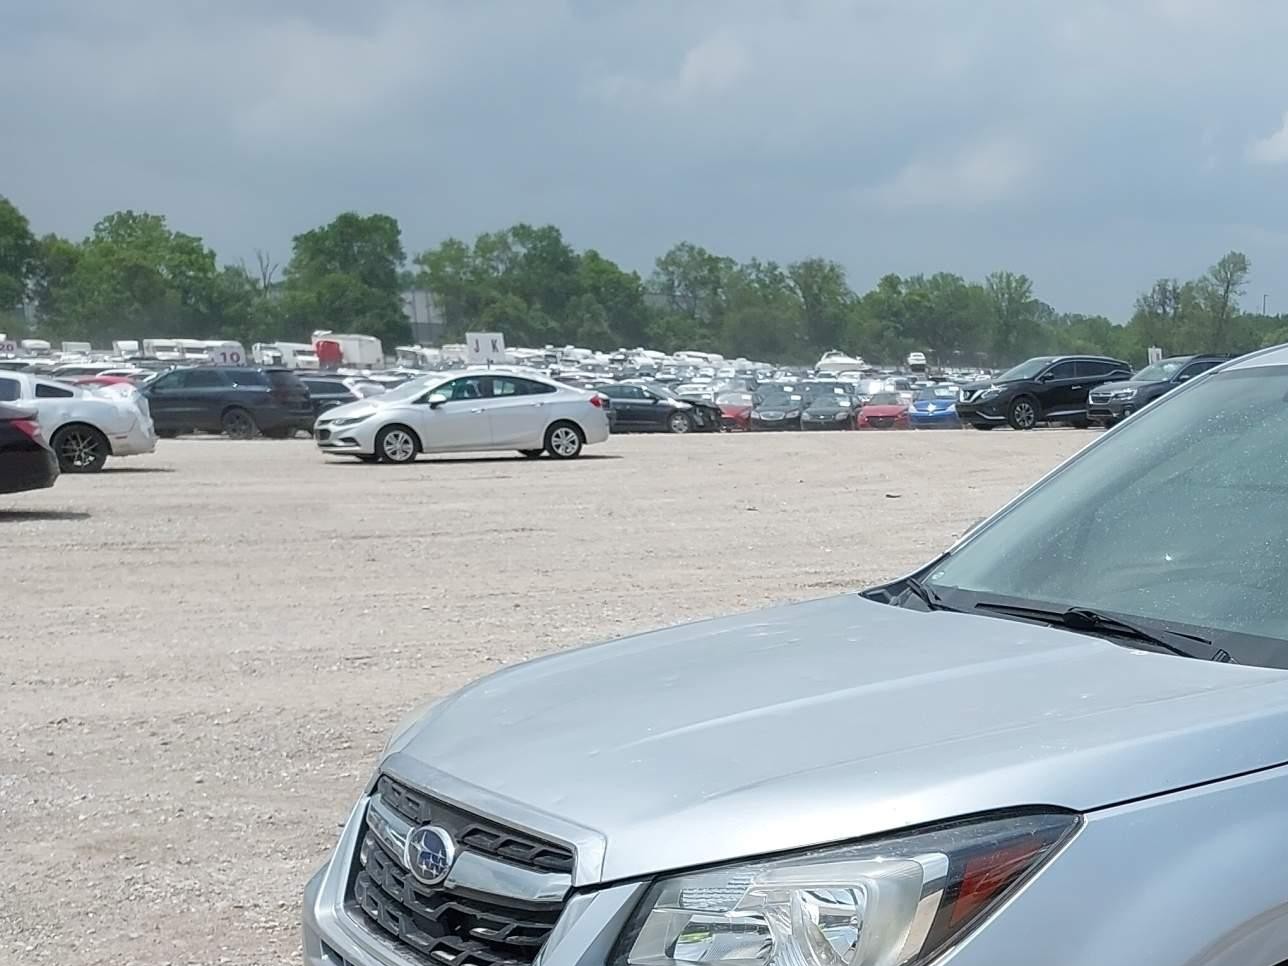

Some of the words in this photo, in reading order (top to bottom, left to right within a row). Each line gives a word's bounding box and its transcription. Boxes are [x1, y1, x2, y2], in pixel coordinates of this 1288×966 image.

[473, 339, 480, 353] J
[490, 339, 499, 353] K
[220, 351, 241, 364] 10
